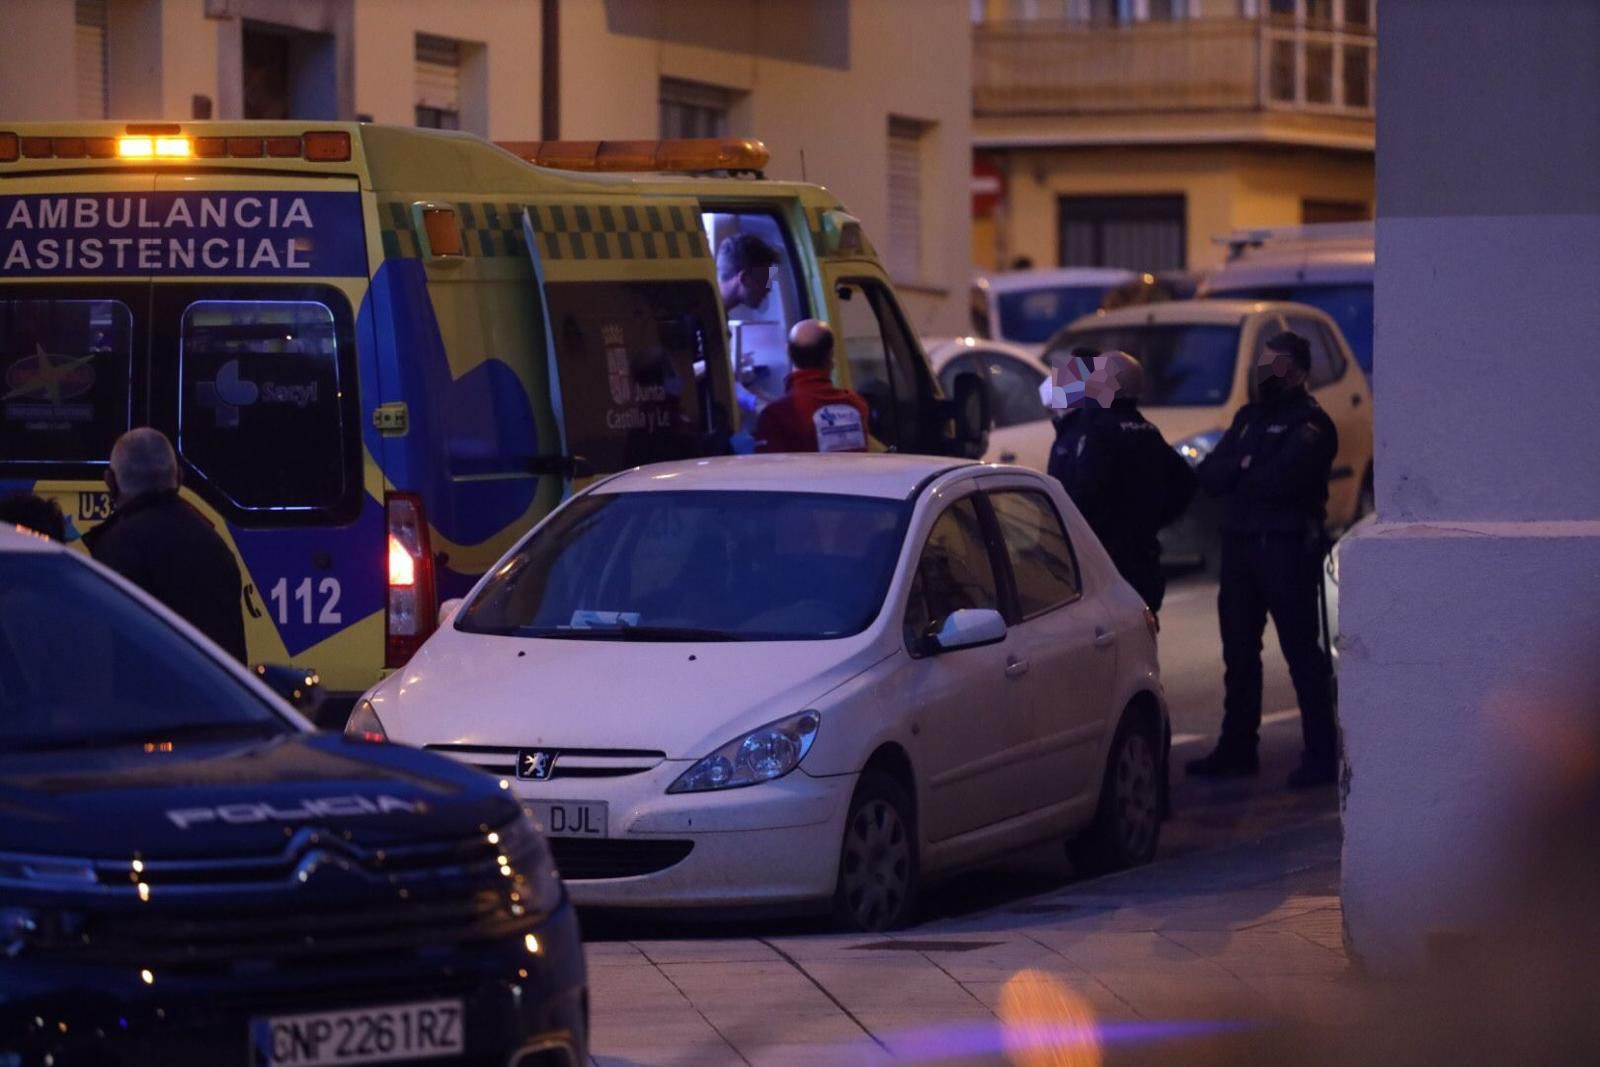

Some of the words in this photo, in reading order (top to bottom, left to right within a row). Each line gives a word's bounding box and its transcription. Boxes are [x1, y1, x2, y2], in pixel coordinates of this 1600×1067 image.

[6, 197, 314, 229] AMBULANCIA
[3, 237, 311, 270] ASISTENCIAL
[81, 492, 116, 520] U-3
[270, 576, 342, 625] 112
[165, 795, 416, 829] POLICIA
[550, 806, 600, 833] DJL
